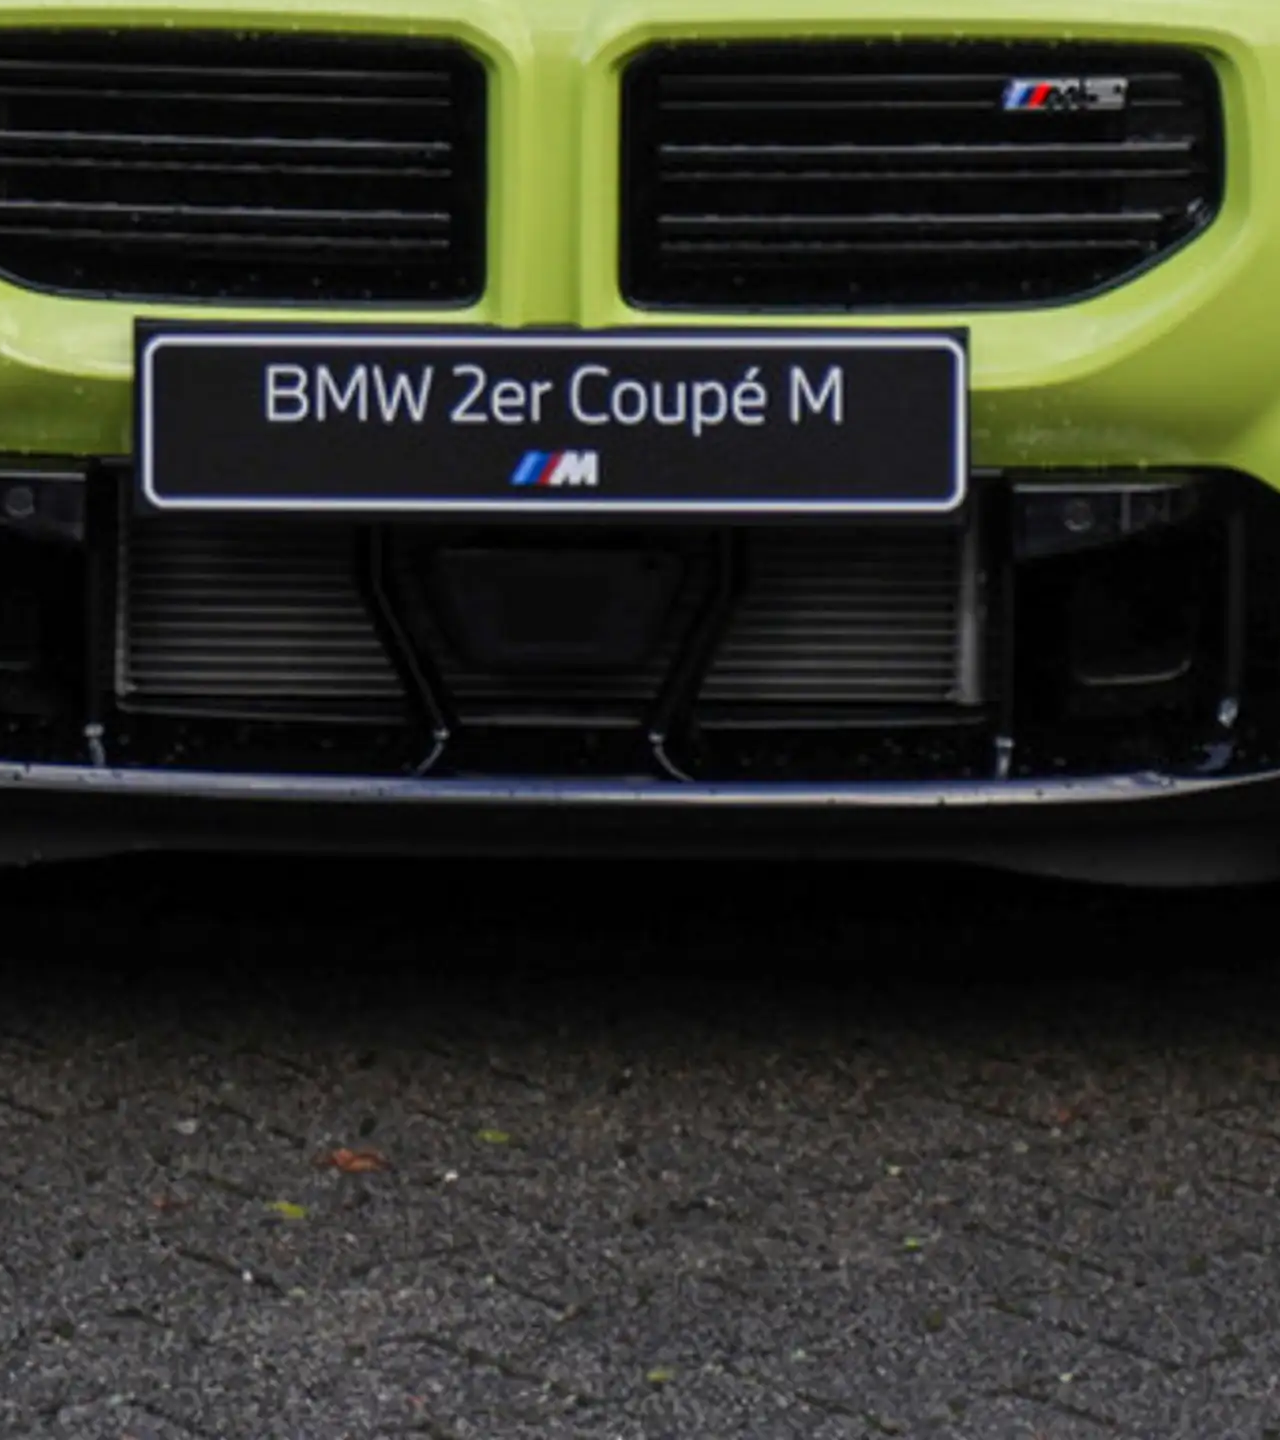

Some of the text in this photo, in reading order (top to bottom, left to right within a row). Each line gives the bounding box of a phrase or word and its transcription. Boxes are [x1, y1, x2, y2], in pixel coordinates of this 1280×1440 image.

[265, 364, 843, 438] BMW 2er Coupé M
